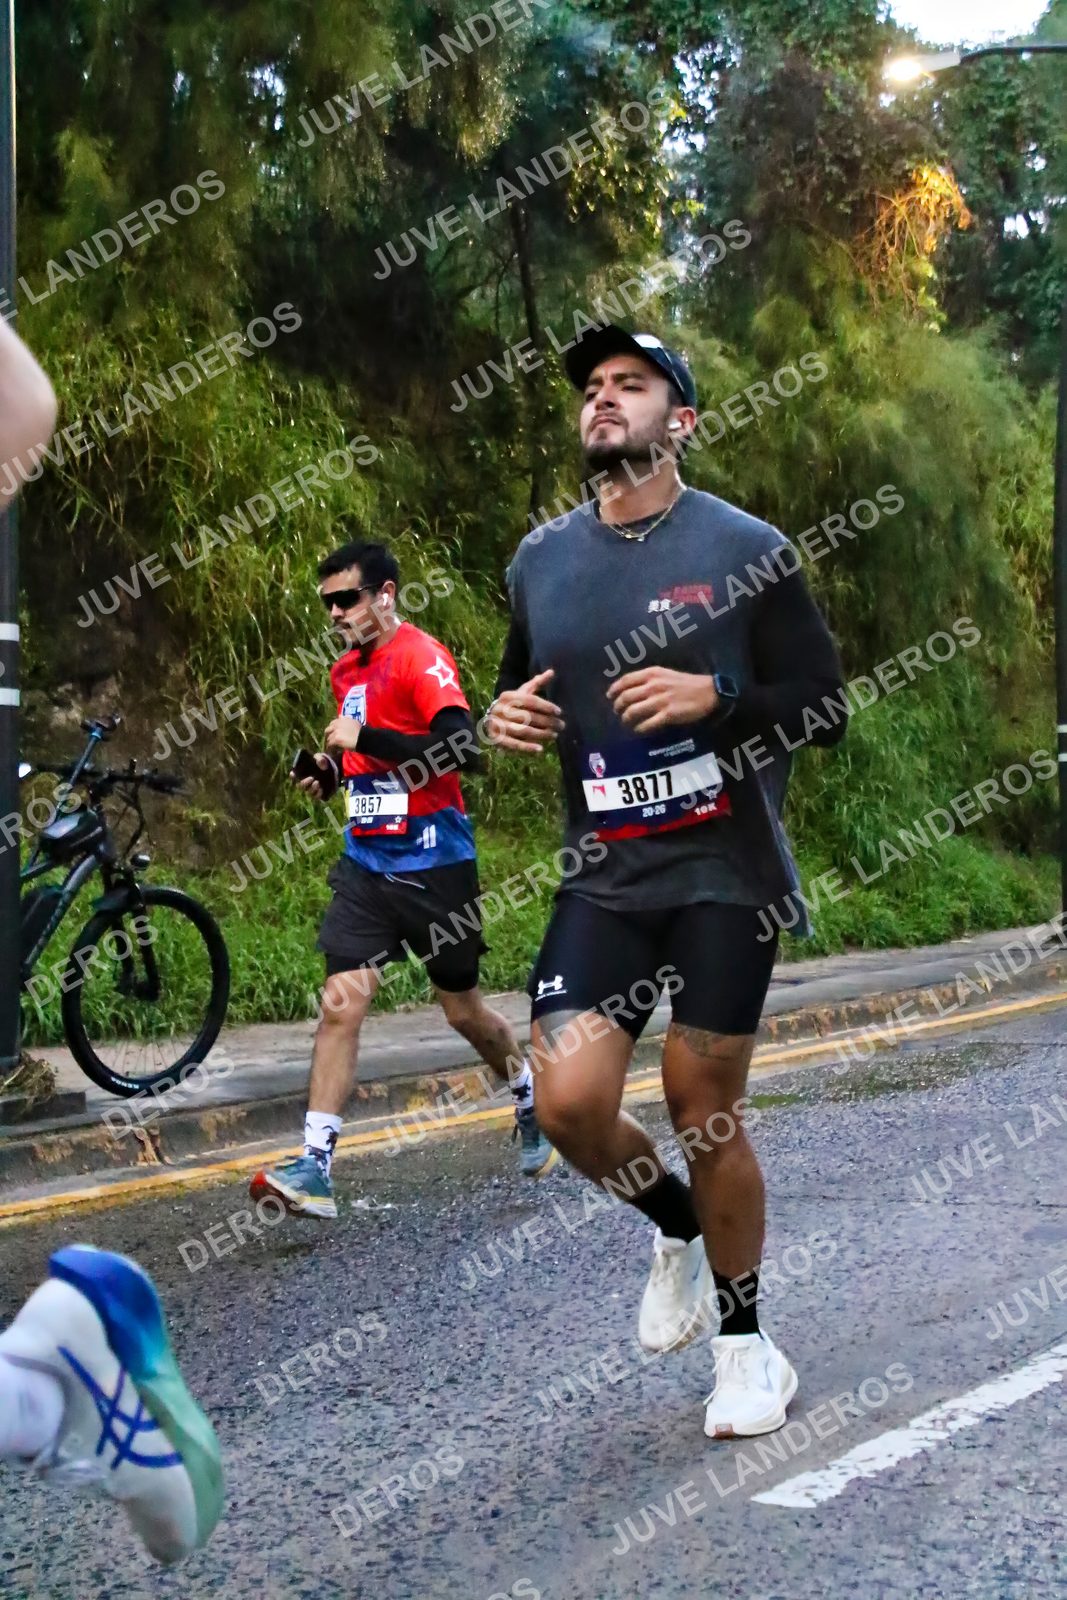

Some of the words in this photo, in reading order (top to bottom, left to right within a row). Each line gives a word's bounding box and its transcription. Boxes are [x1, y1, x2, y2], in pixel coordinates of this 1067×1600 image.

[618, 770, 673, 805] 3877
[354, 796, 382, 813] 3857
[695, 803, 717, 816] 10K
